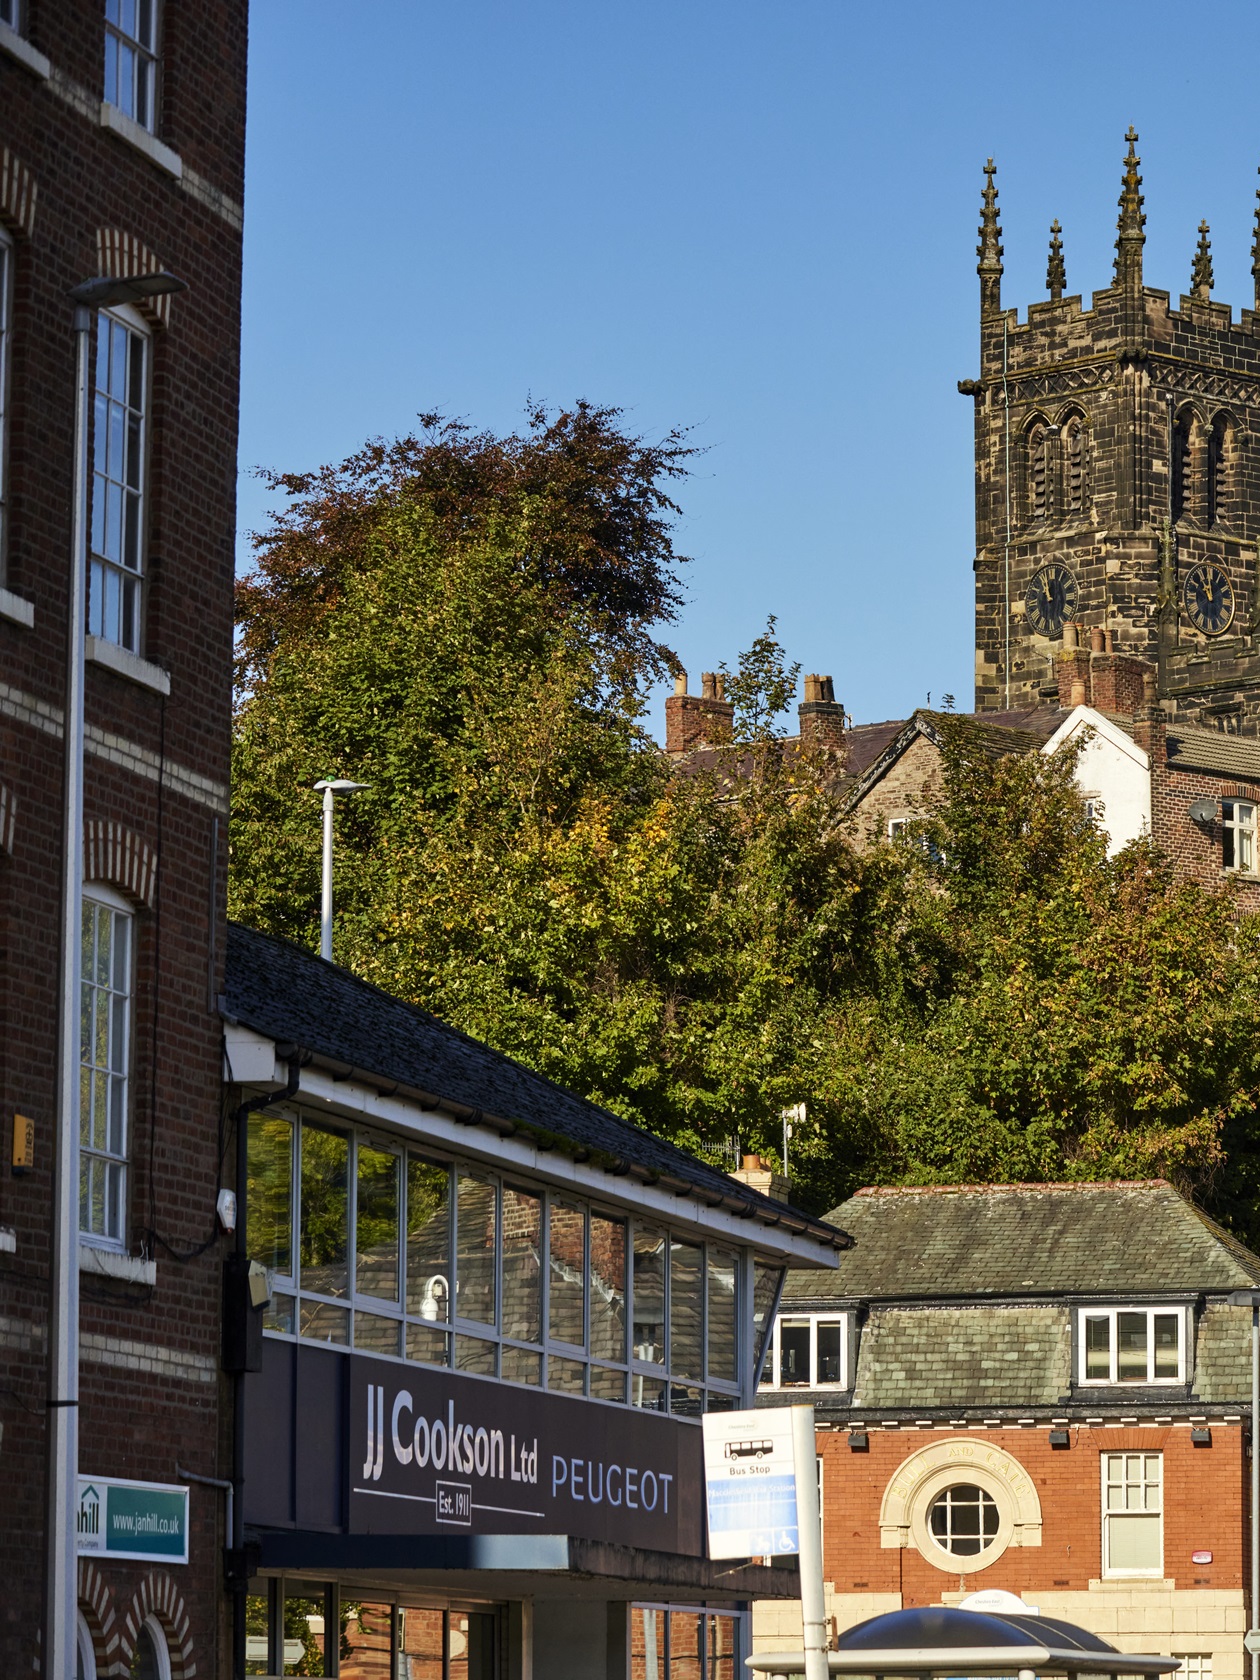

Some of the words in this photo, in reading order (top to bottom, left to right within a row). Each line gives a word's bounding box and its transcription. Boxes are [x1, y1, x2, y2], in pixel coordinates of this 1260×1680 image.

[363, 1384, 384, 1481] JJ
[391, 1389, 505, 1479] Cookson
[511, 1434, 538, 1484] Ltd
[553, 1455, 673, 1514] PEUGEOT
[729, 1467, 746, 1476] Bus
[749, 1465, 771, 1475] Stop
[891, 1454, 936, 1499] BULL
[949, 1446, 974, 1458] AND
[439, 1491, 454, 1514] Est.
[456, 1493, 469, 1516] 1911
[112, 1511, 179, 1536] www.janhill.co.uk
